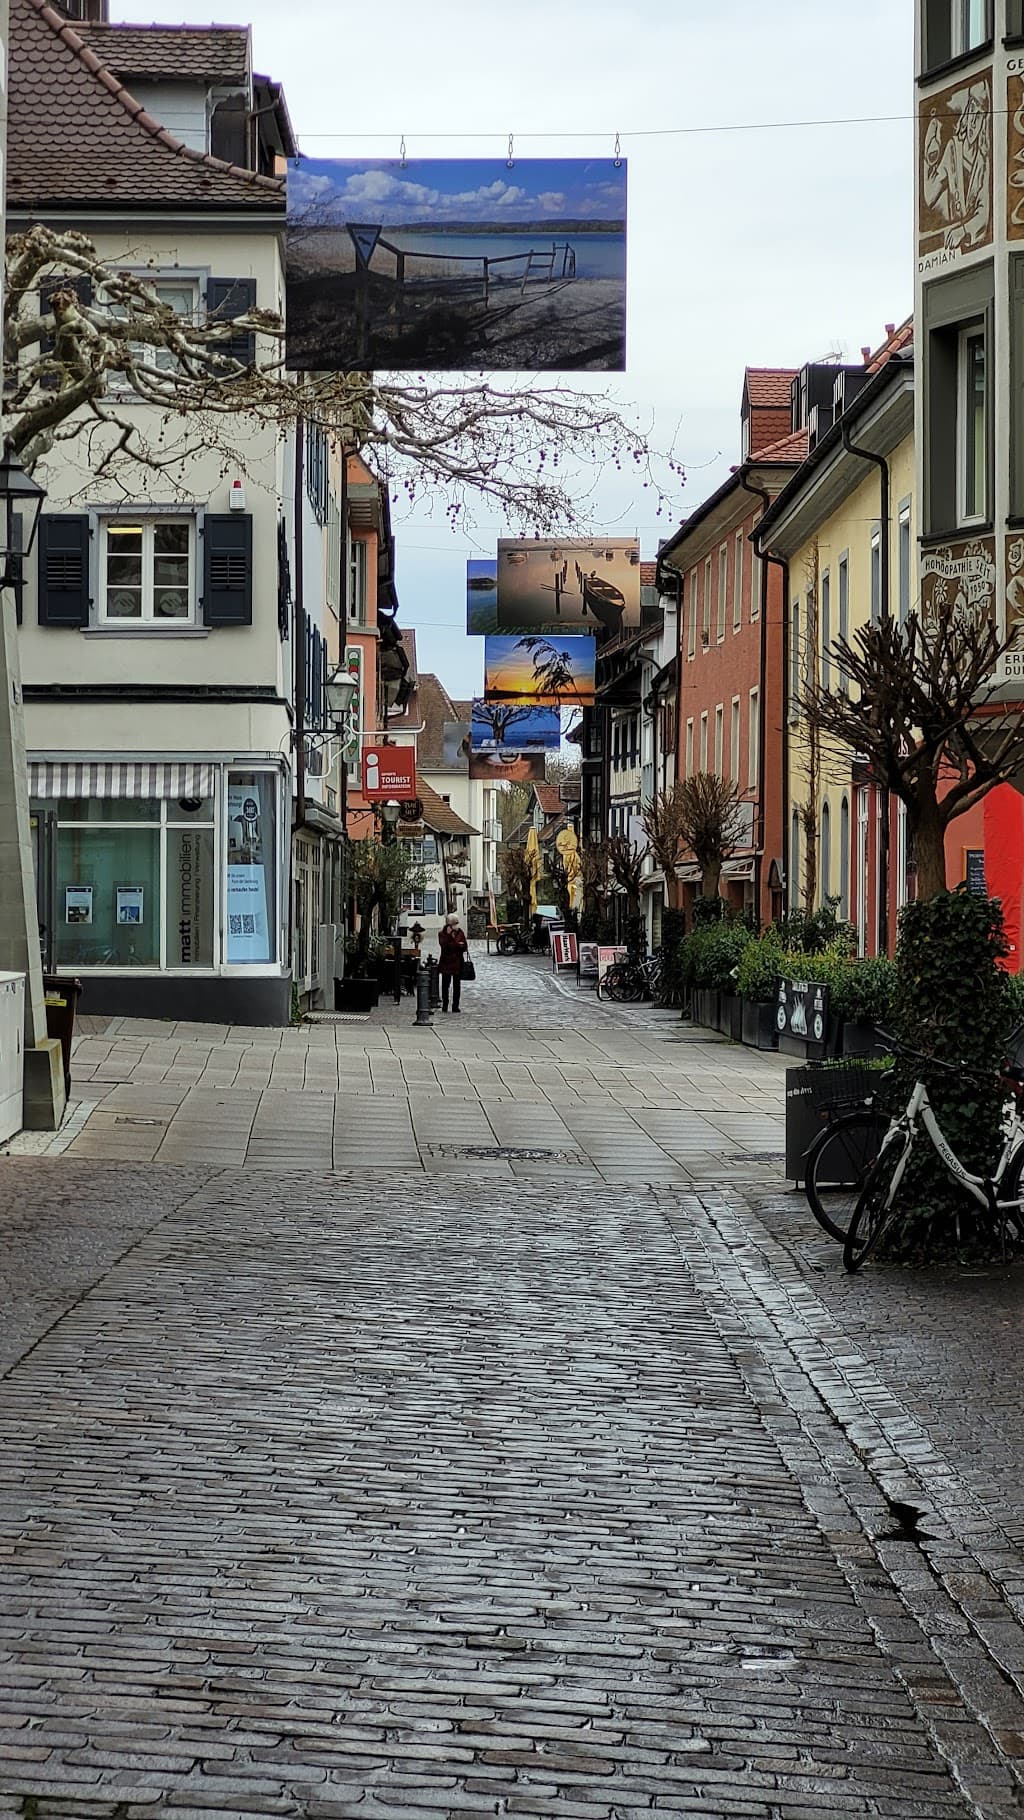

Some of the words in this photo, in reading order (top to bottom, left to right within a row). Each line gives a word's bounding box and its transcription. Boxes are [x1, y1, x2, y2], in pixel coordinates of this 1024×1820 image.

[918, 250, 956, 273] DAMIAN
[976, 559, 991, 579] SEIT
[1005, 655, 1024, 664] ER
[1005, 666, 1024, 675] DU
[381, 776, 411, 784] TOURIST
[179, 834, 192, 915] immobilien
[179, 919, 191, 962] matt
[938, 1142, 967, 1178] PEGASUS
